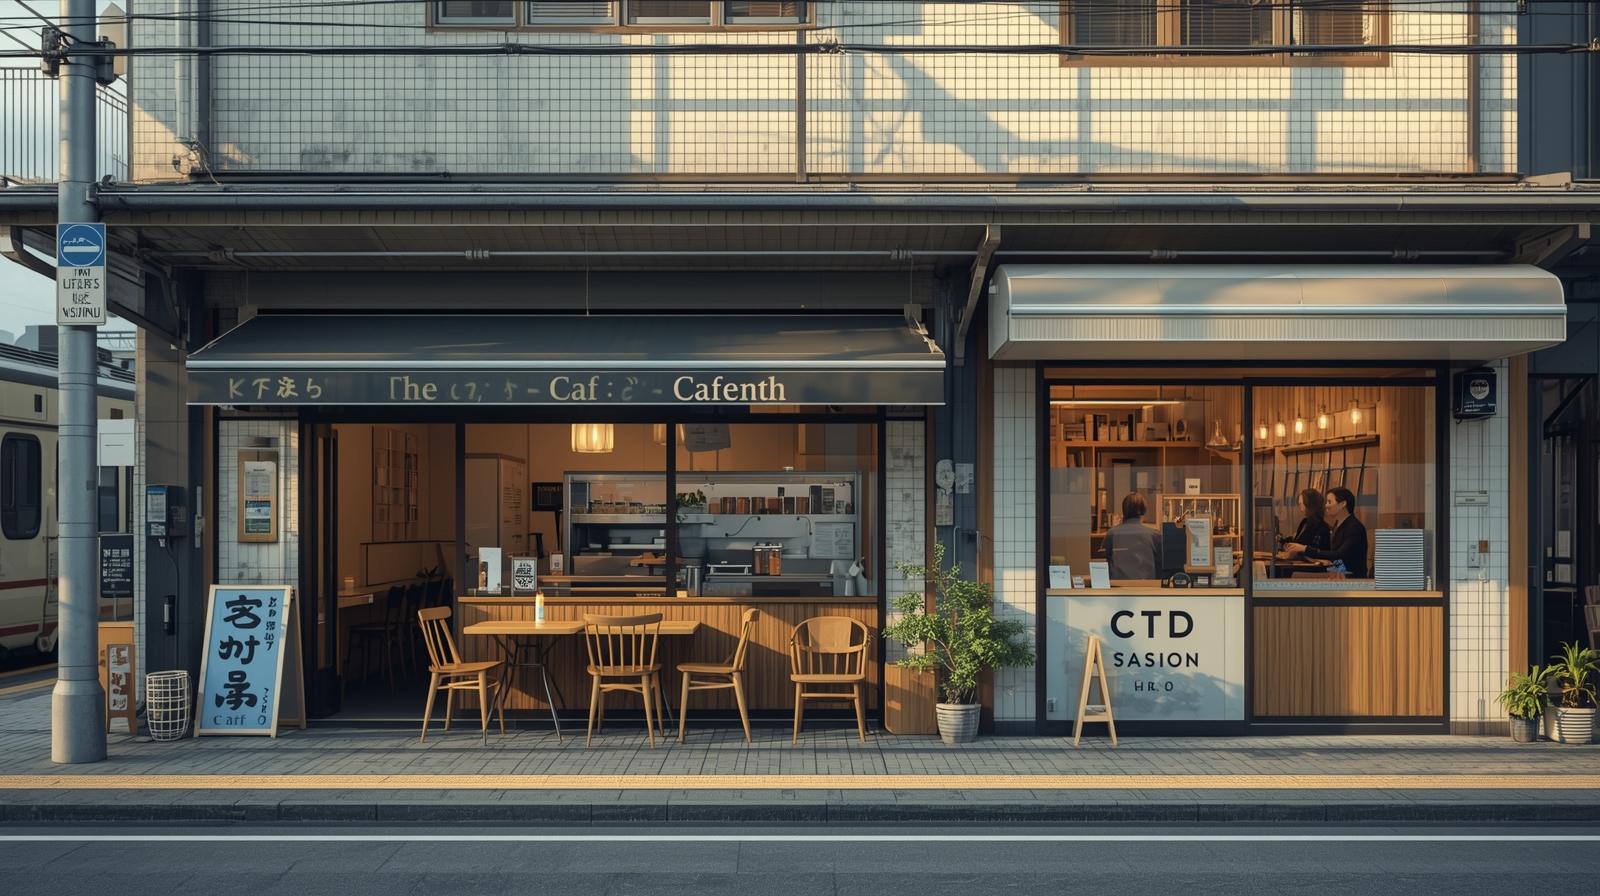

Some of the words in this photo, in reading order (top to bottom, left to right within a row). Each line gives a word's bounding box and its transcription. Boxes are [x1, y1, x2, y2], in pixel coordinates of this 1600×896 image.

[673, 376, 786, 401] Cafenth
[1110, 610, 1194, 639] CTD
[1113, 652, 1199, 668] SASION
